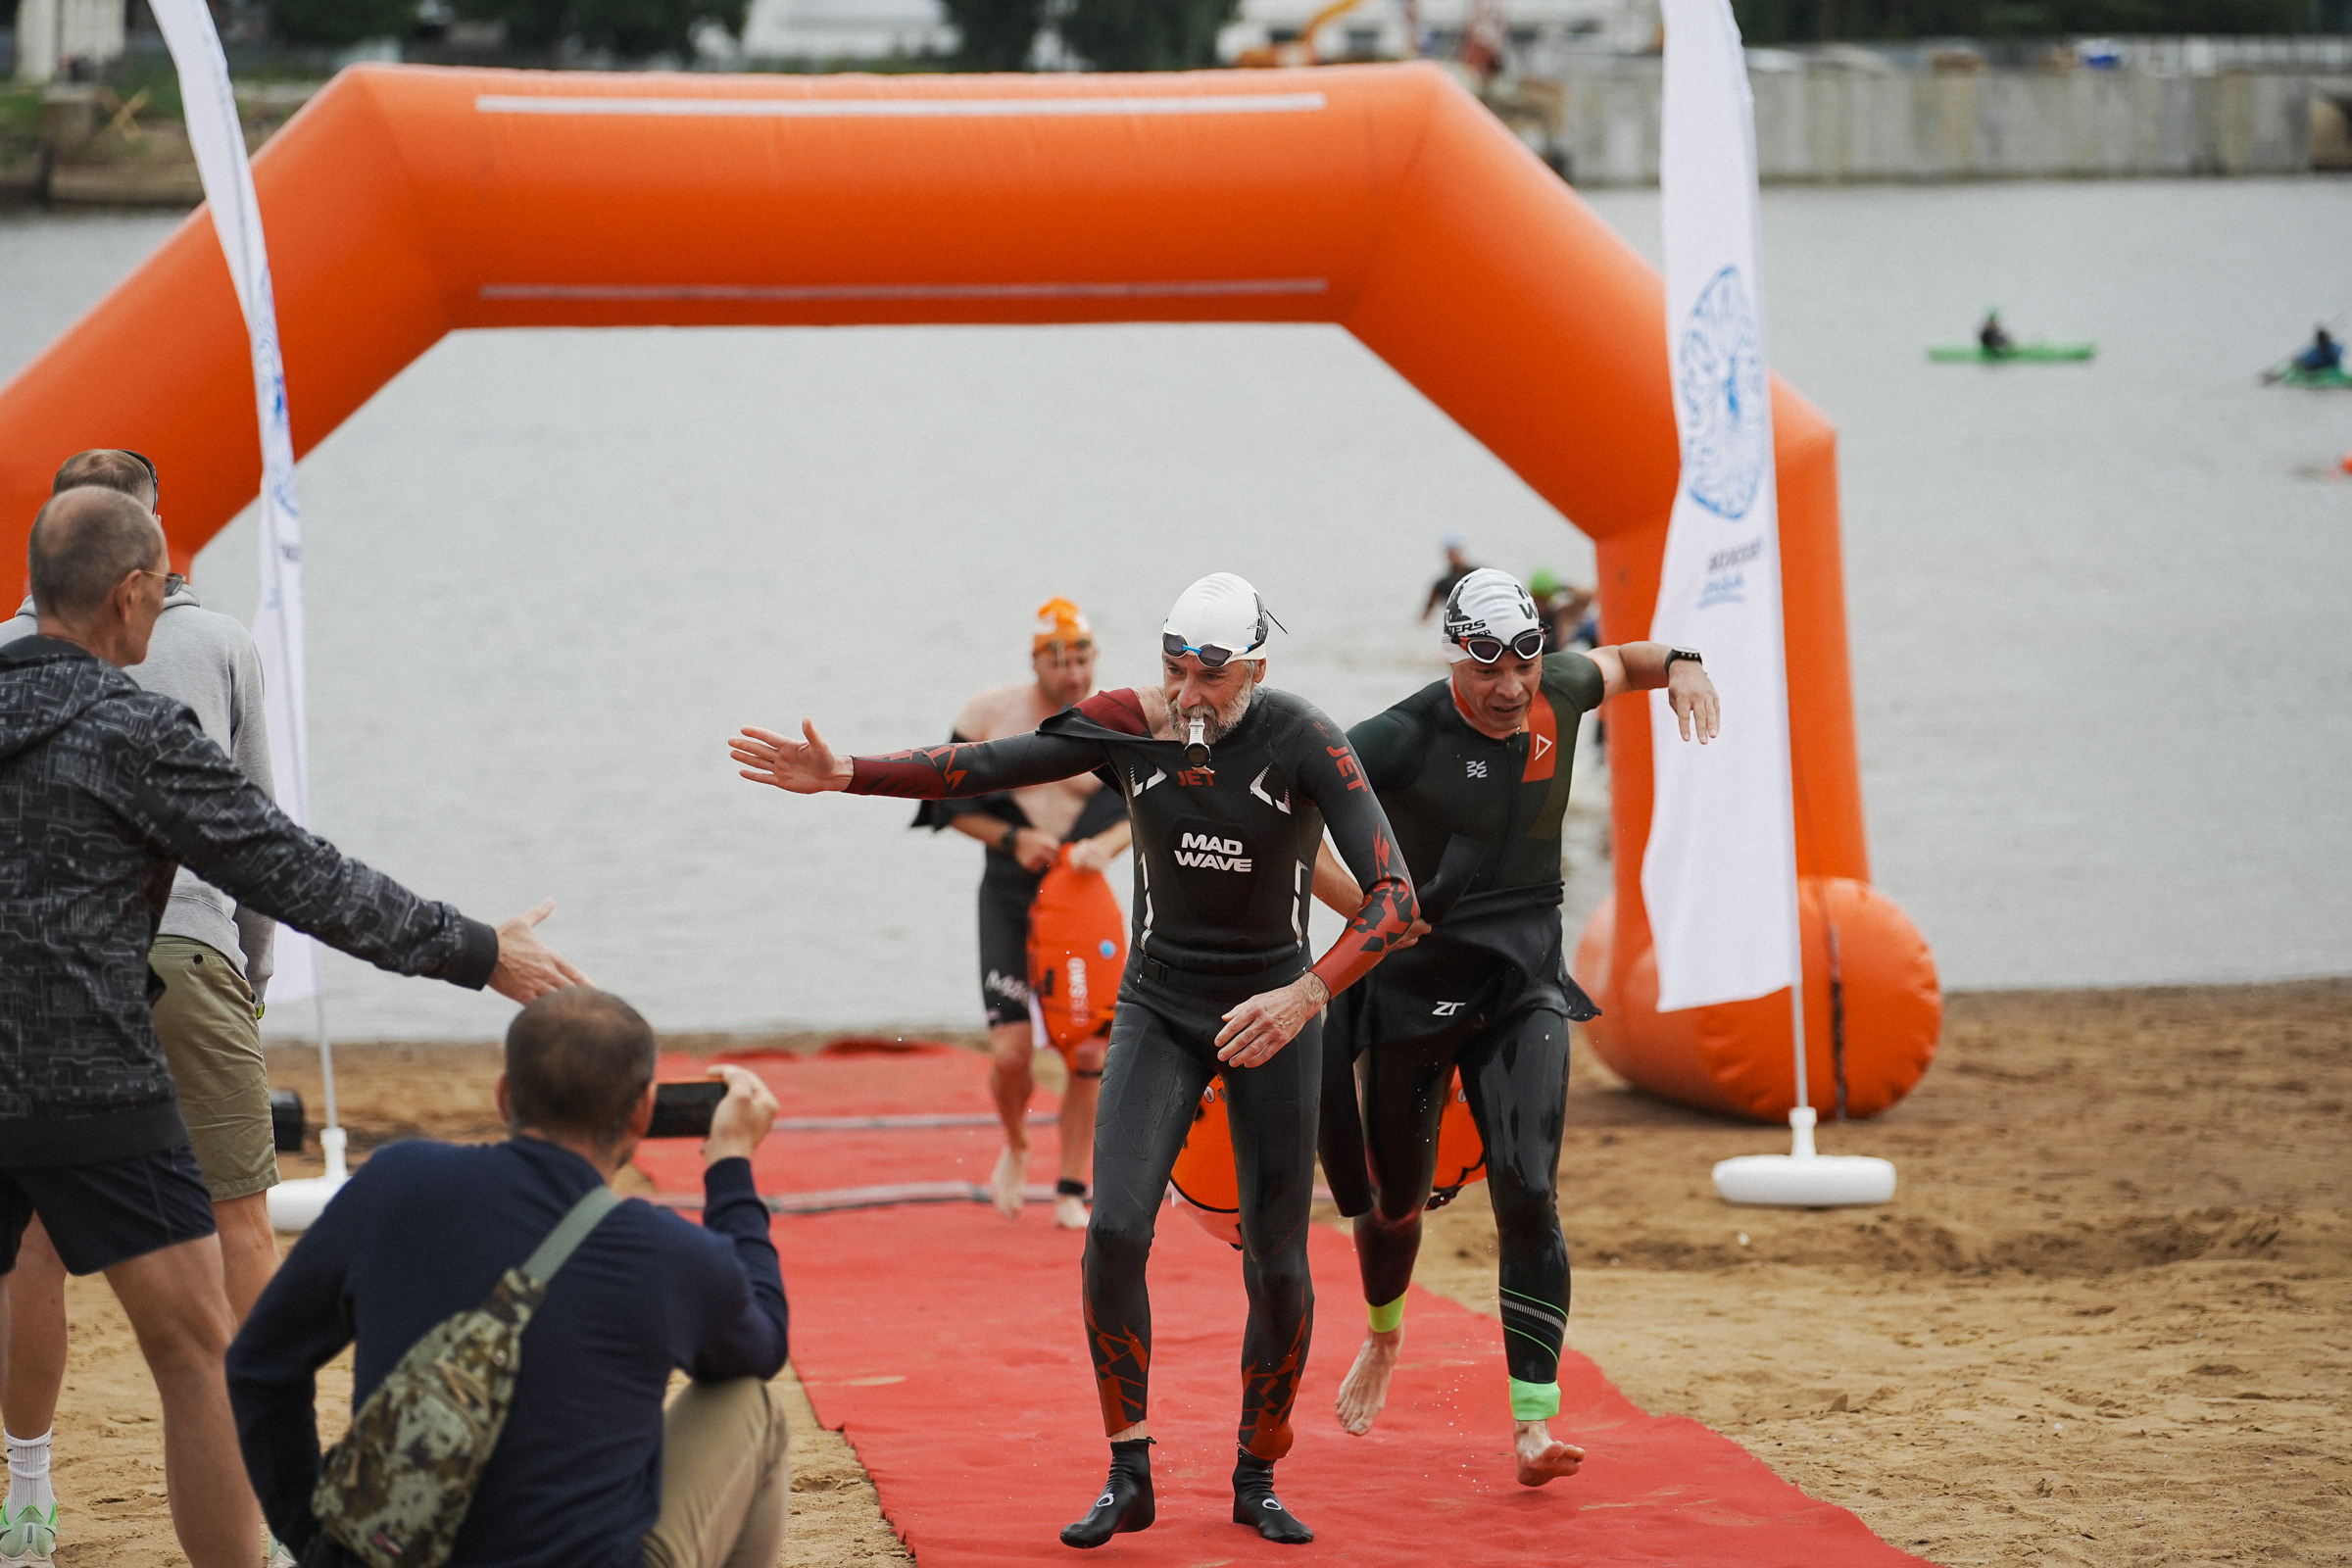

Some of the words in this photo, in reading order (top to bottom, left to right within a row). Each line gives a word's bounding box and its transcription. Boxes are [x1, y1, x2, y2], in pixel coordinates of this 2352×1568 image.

[1177, 769, 1217, 786] JET
[1326, 746, 1368, 792] JET
[1181, 832, 1243, 856] MAD
[1174, 850, 1252, 872] WAVE
